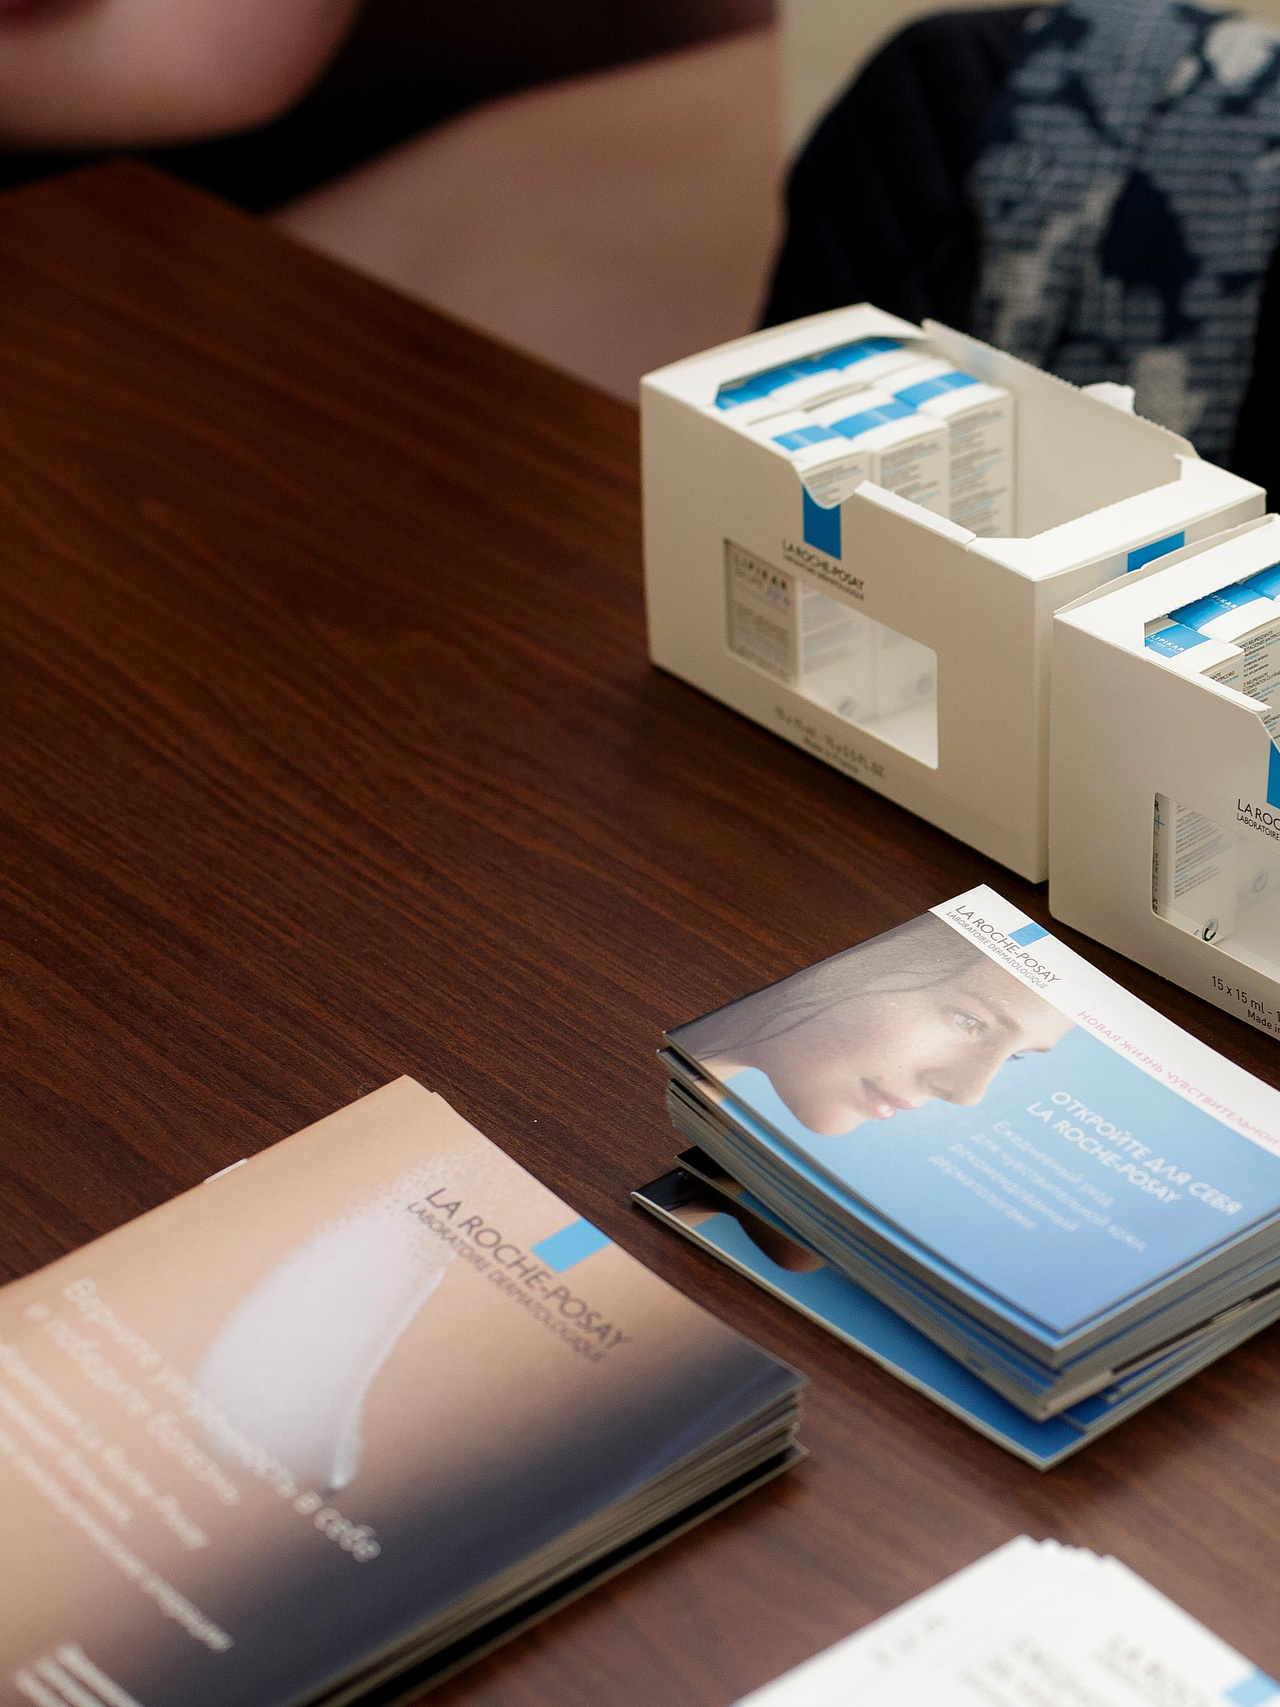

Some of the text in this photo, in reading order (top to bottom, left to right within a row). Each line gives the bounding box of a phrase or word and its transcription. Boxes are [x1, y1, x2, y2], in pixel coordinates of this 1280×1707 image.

[1236, 812, 1280, 842] LABORATOIRE
[1237, 798, 1253, 817] LA
[945, 911, 1049, 990] LABORATOIRE DERMATOLOGIQUE
[955, 904, 1062, 984] LA ROCHE-POSAY
[1211, 975, 1224, 991] 15
[1226, 985, 1233, 996] x
[1235, 988, 1248, 1004] 15
[1250, 999, 1265, 1014] ml
[1247, 1009, 1272, 1030] Made
[1077, 1010, 1122, 1043] НОВАЯ
[1120, 1039, 1164, 1073] ЖИЗНЬ
[1026, 1101, 1183, 1204] LA ROCHE-POSAY
[1050, 1090, 1244, 1216] ОТКРОЙТЕ ДЛЯ СЕБЯ
[425, 1186, 633, 1349] LA ROCHE-POSAY
